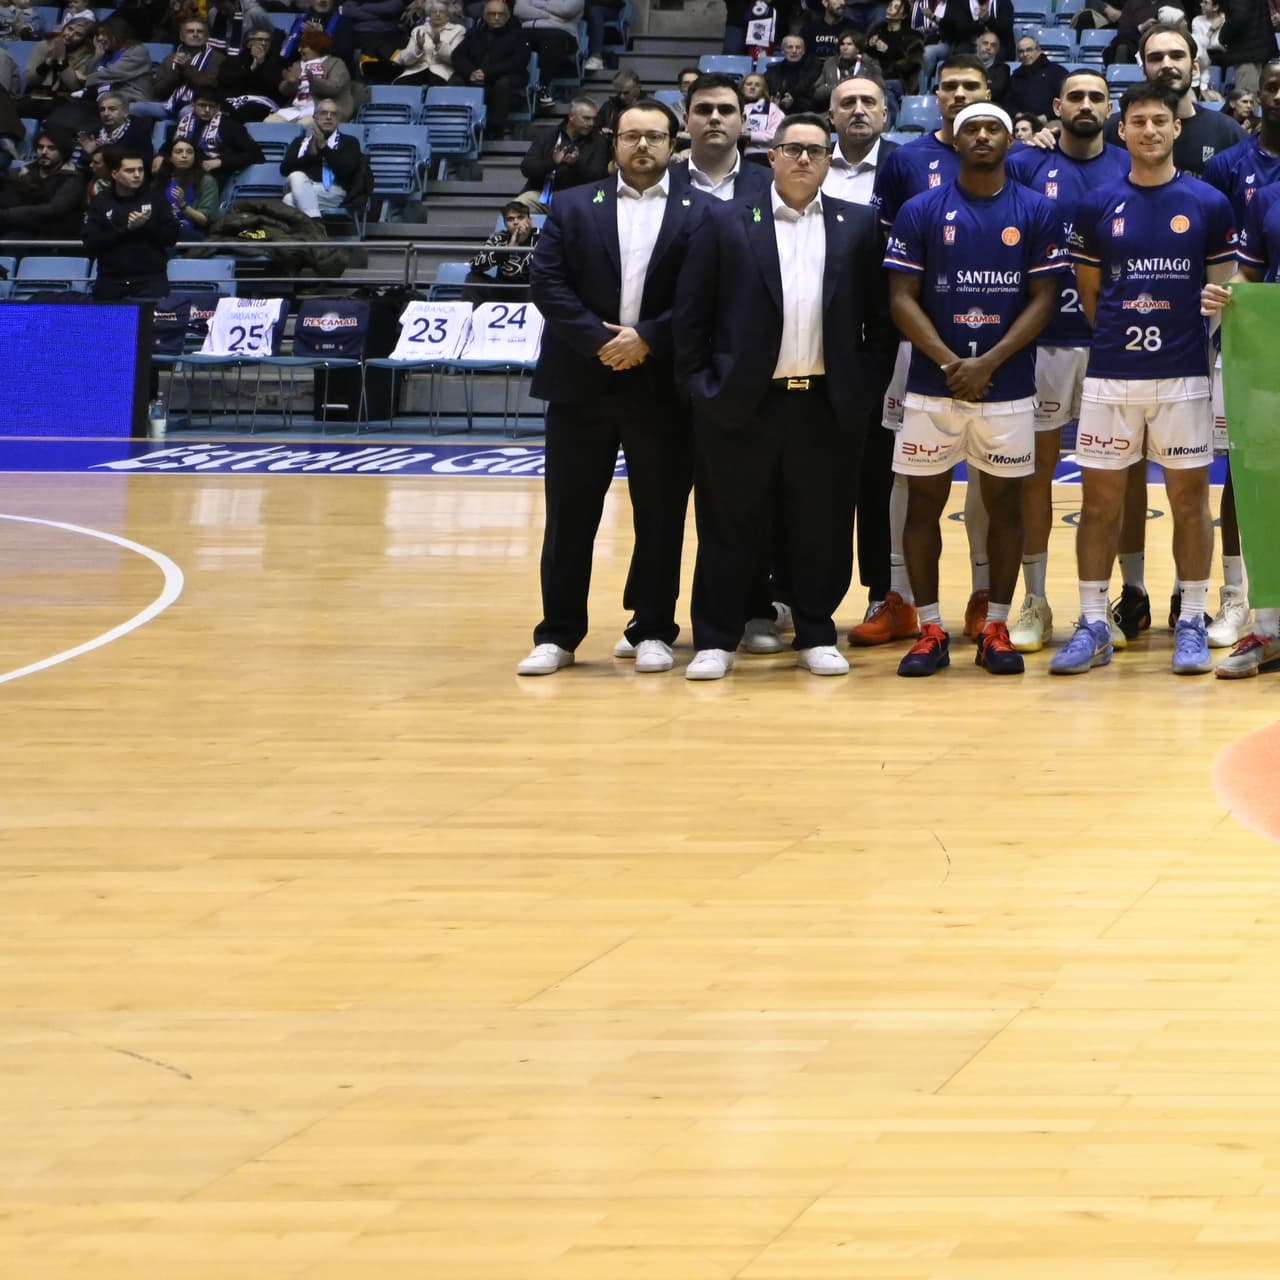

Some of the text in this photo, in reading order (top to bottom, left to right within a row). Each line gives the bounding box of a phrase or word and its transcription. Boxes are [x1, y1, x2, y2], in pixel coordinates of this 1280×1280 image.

[956, 270, 1021, 285] SANTIAGO
[1127, 258, 1191, 272] SANTIAGO
[1060, 288, 1084, 313] 2
[1122, 300, 1171, 310] PESCAMAR
[302, 317, 358, 327] PESCAMAR
[488, 305, 528, 330] 24
[228, 325, 263, 352] 25
[408, 318, 448, 344] 23
[1125, 326, 1162, 352] 28
